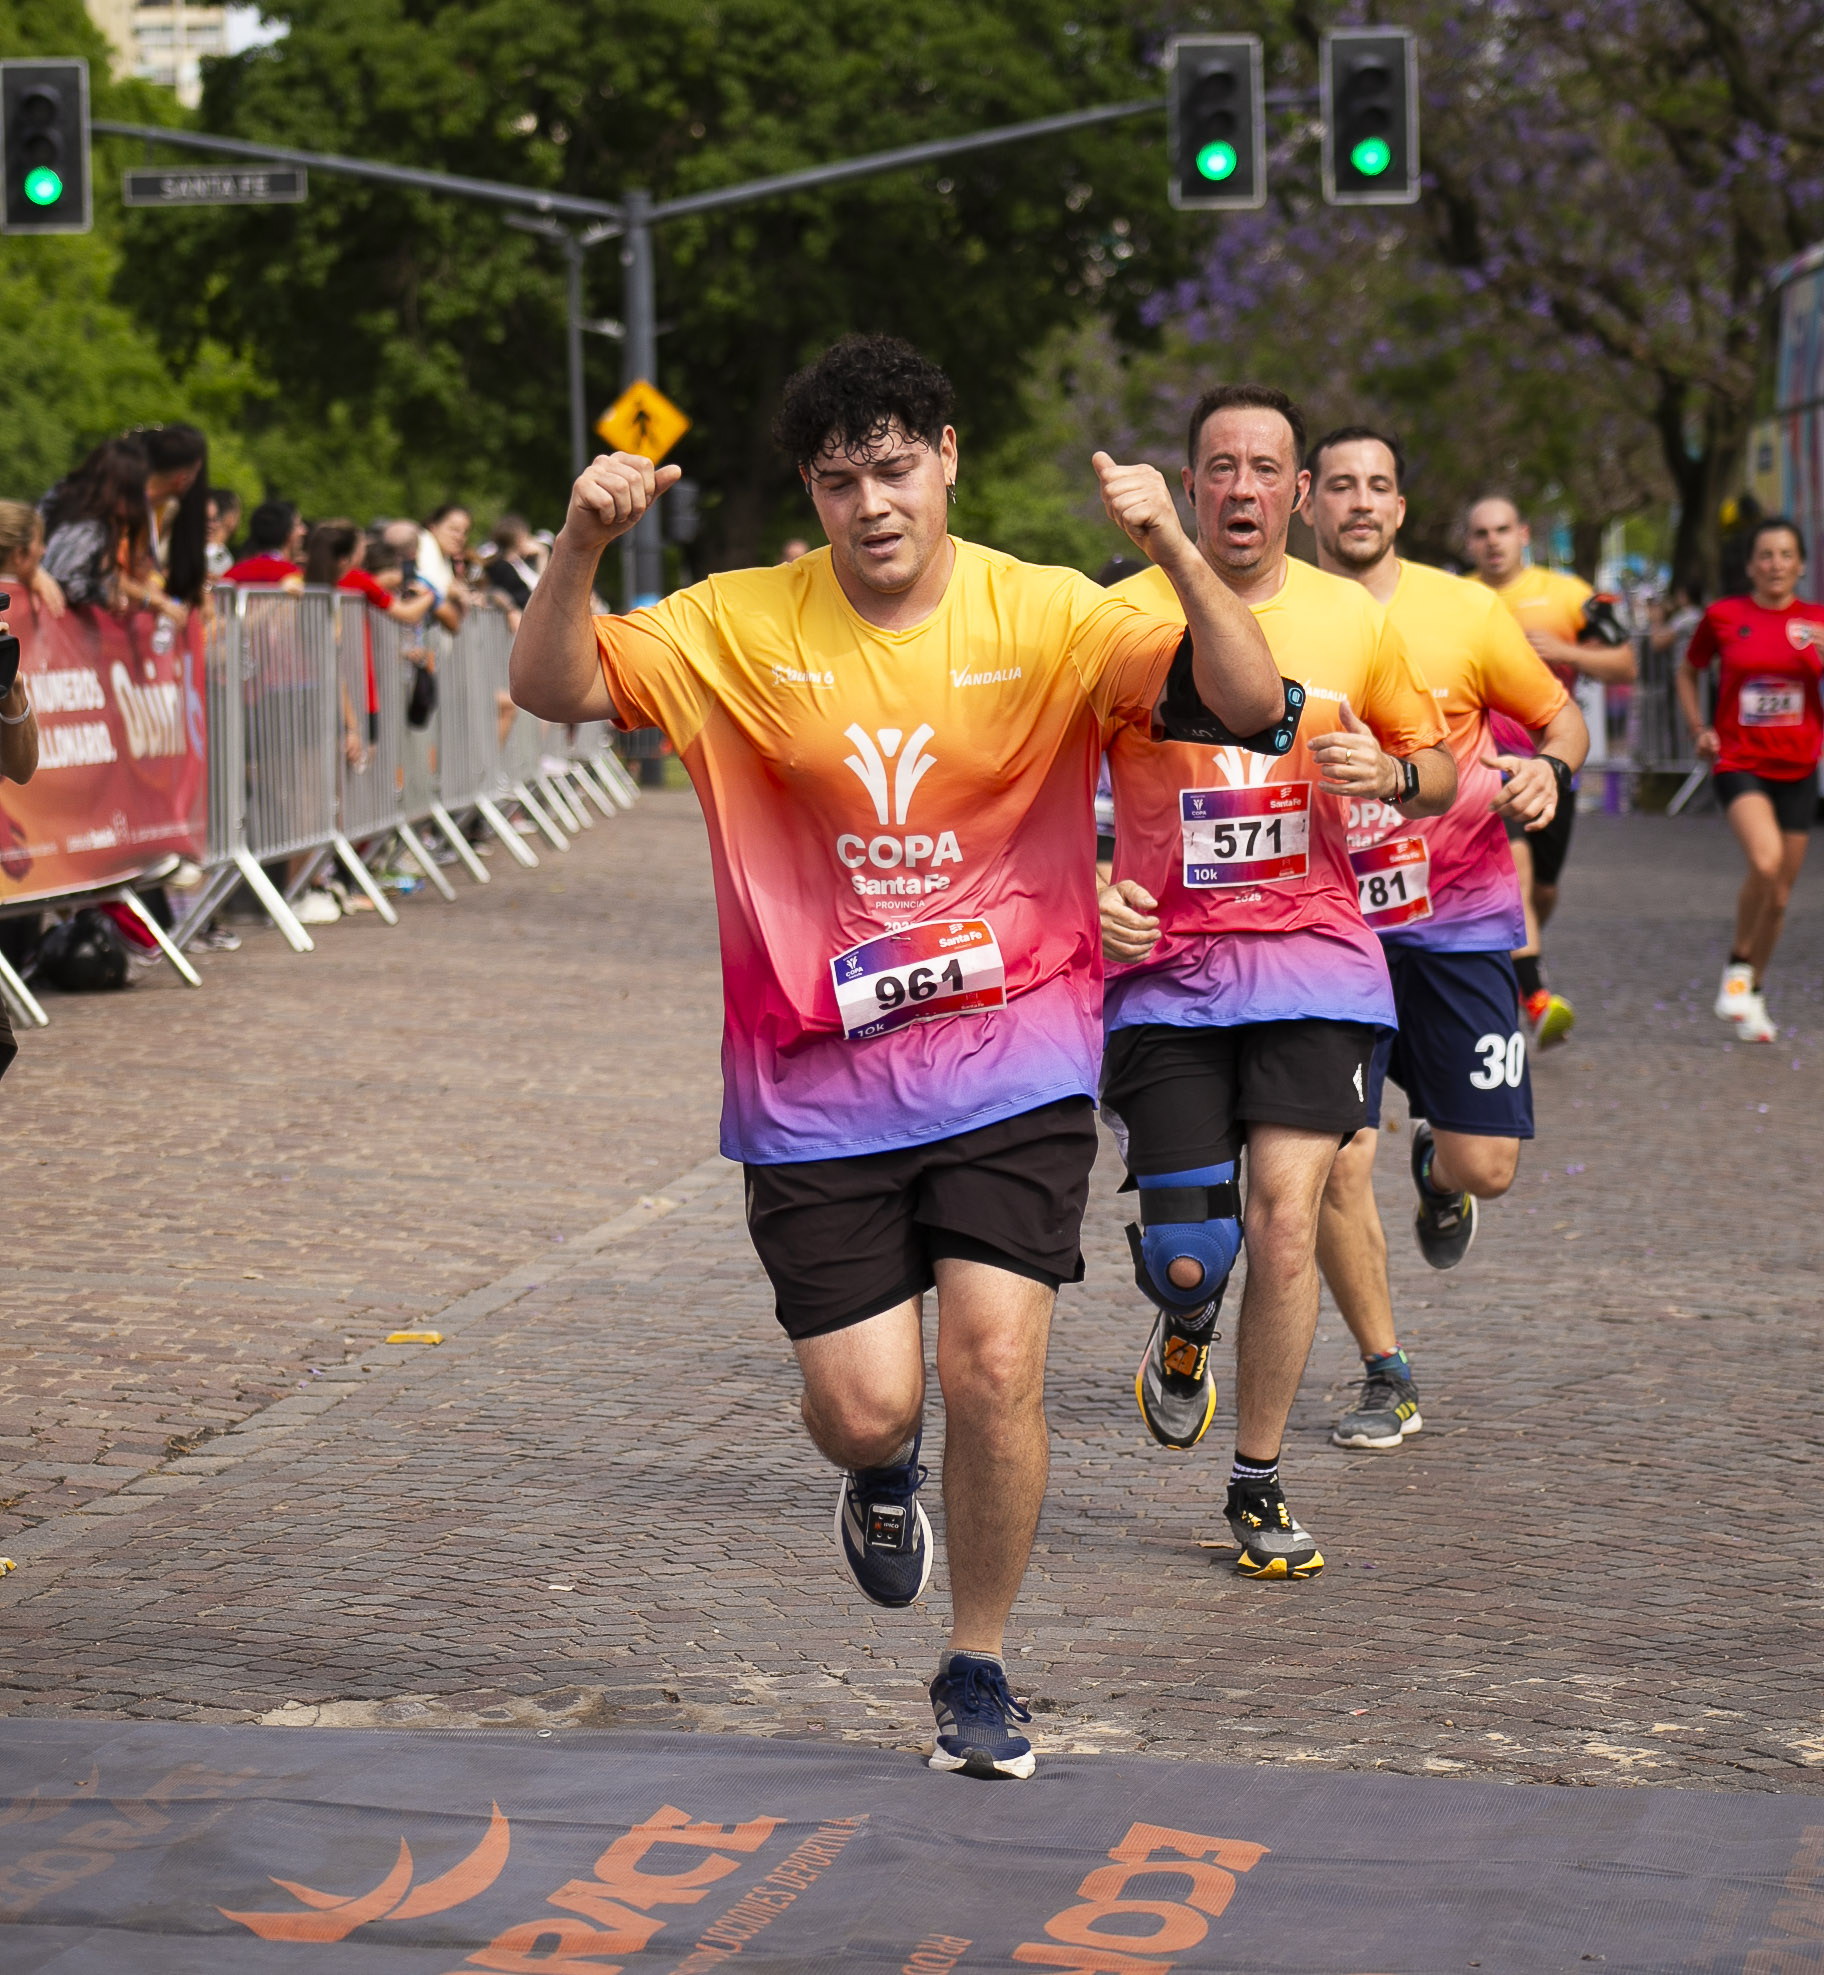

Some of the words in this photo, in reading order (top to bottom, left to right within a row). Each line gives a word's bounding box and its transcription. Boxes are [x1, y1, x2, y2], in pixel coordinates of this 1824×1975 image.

[823, 670, 834, 684] 6
[949, 664, 1022, 688] VANDALIA
[1270, 799, 1292, 809] Santa
[1292, 798, 1302, 806] Fe
[1213, 818, 1282, 859] 571
[836, 830, 964, 869] COPA
[1193, 868, 1218, 881] 10k
[851, 875, 922, 895] Santa
[924, 873, 951, 894] Fe
[875, 899, 926, 910] PROVINCIA
[884, 920, 918, 932] 202
[939, 934, 970, 948] Santa
[969, 931, 982, 940] Fe
[845, 966, 864, 977] COPA
[875, 958, 964, 1011] 961
[857, 1023, 885, 1038] 10k
[1469, 1031, 1526, 1090] 30
[442, 1804, 789, 1975] RACE
